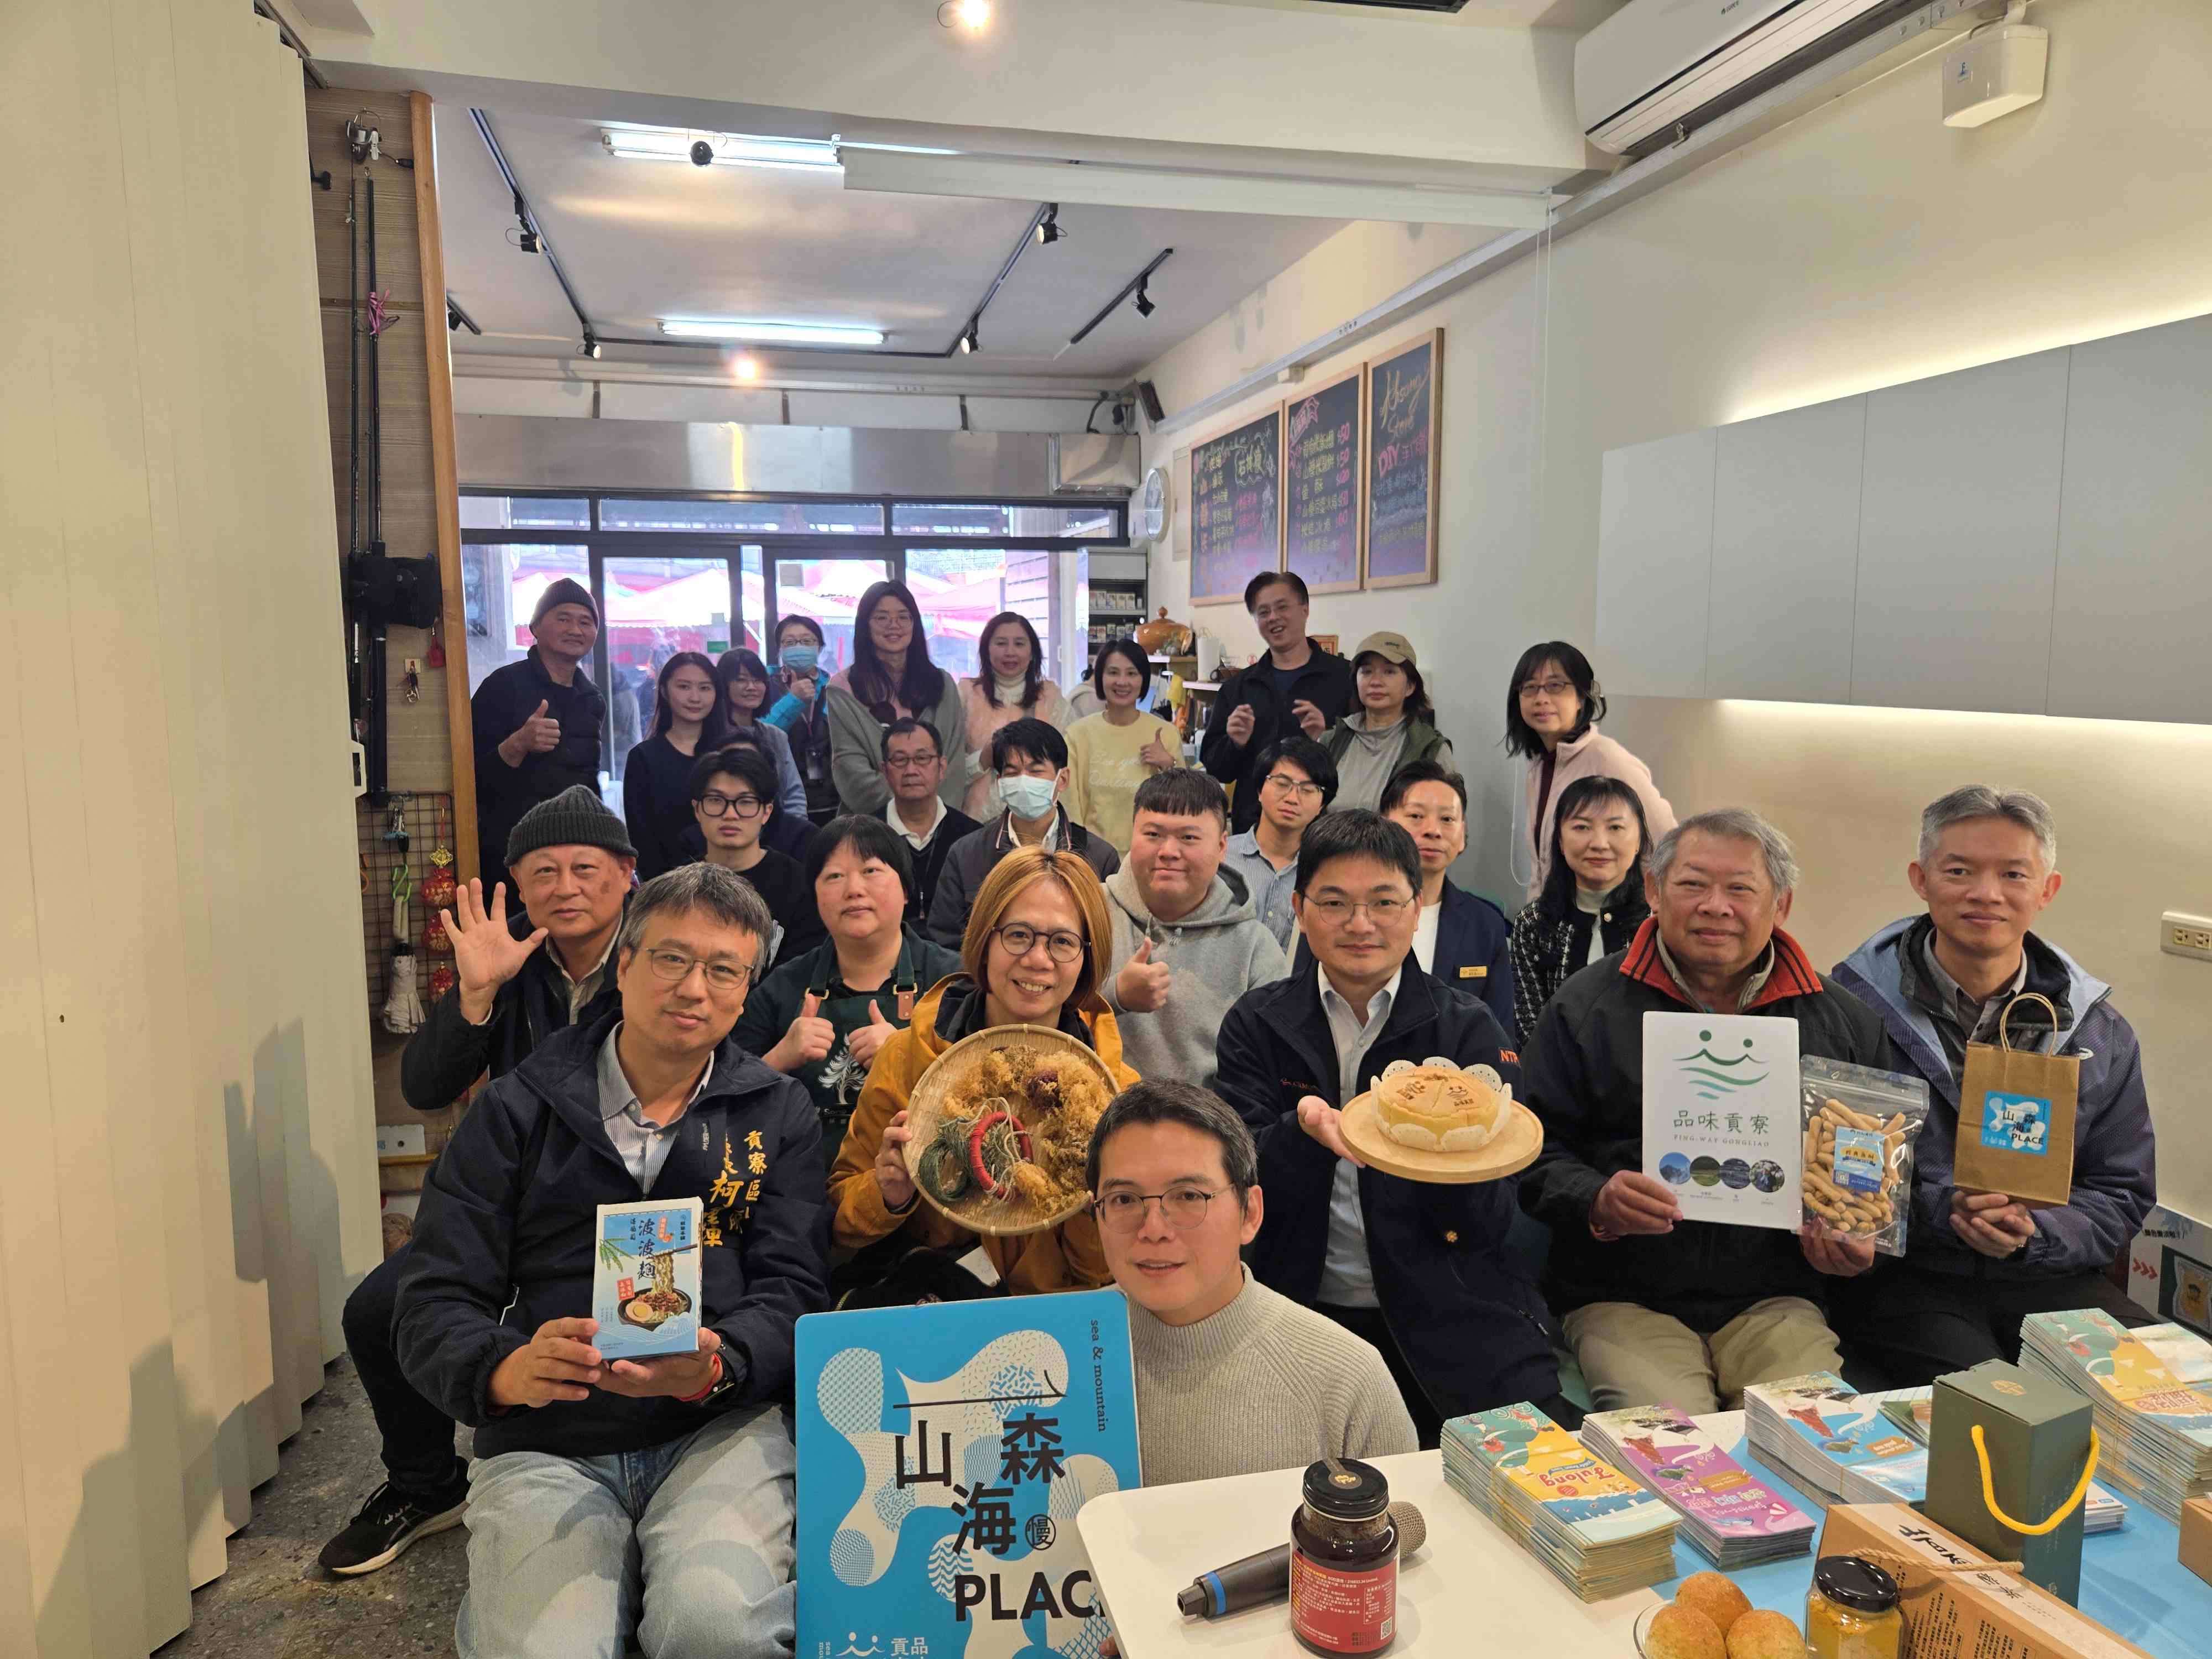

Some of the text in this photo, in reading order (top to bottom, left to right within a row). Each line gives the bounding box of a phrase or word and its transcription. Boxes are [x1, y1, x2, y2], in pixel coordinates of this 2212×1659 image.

[1673, 1110, 1769, 1135] 品味貢寮
[2011, 1133, 2044, 1145] PLACE
[744, 1130, 768, 1219] 貢寮區
[1091, 1319, 1109, 1432] sea & mountain
[951, 1481, 1017, 1555] 海
[1027, 1517, 1053, 1547] 慢
[890, 1636, 928, 1656] 貢品
